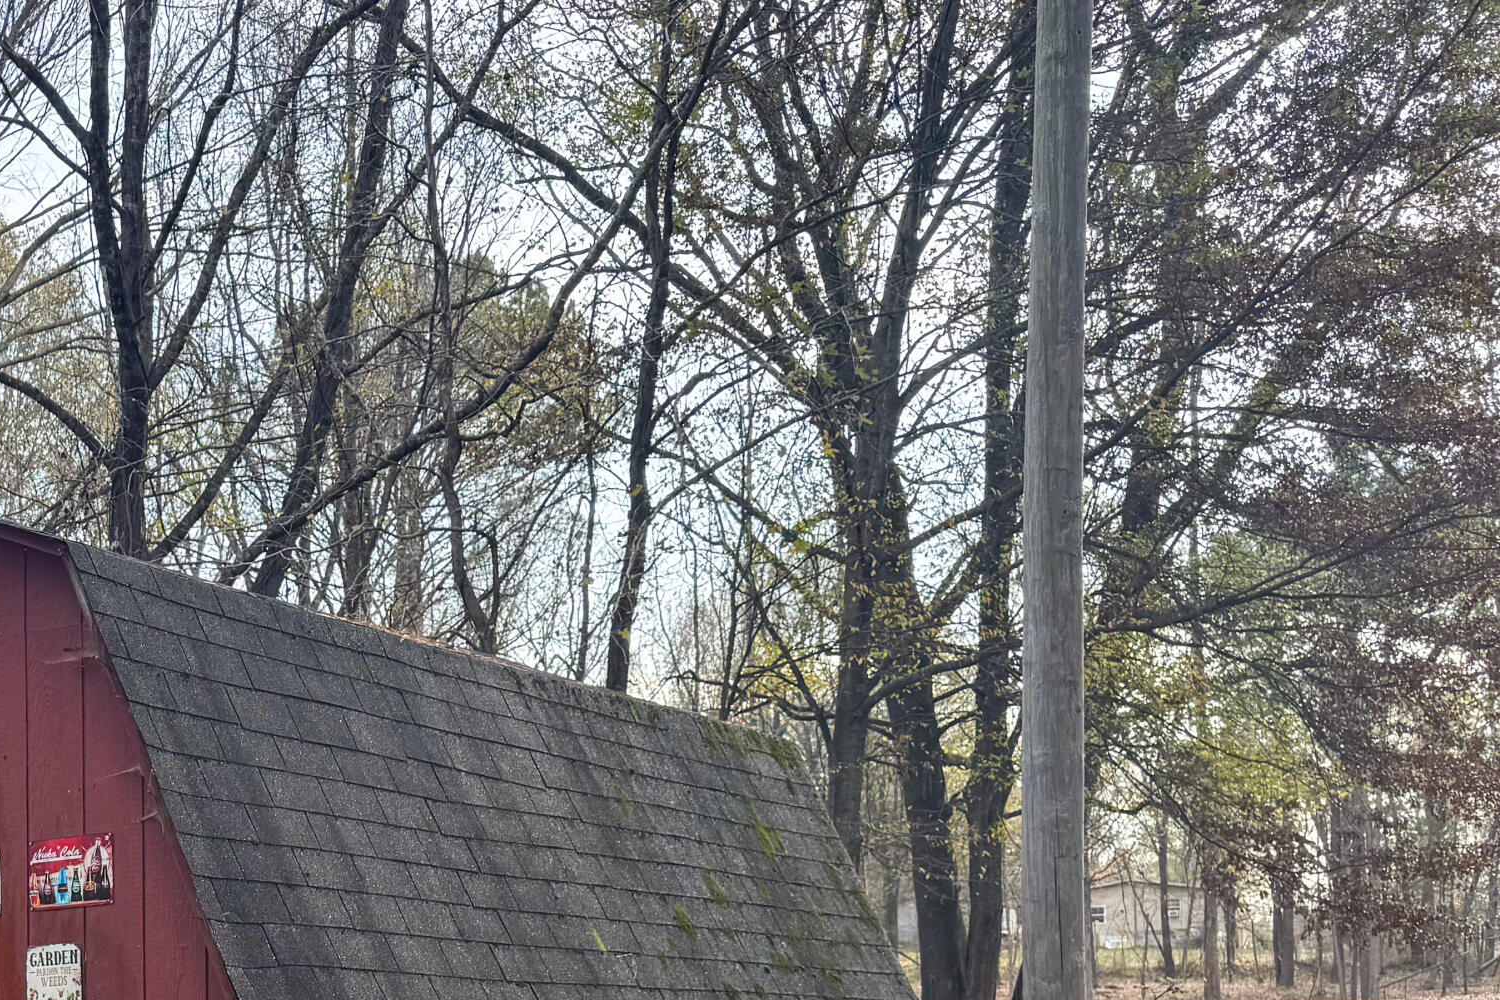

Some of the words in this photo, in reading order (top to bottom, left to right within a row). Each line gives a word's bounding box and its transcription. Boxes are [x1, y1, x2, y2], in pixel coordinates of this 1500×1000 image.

[58, 845, 80, 857] Cola
[29, 949, 78, 968] GARDEN
[36, 967, 59, 977] PARDON
[60, 966, 72, 975] THE
[41, 975, 68, 987] WEEDS
